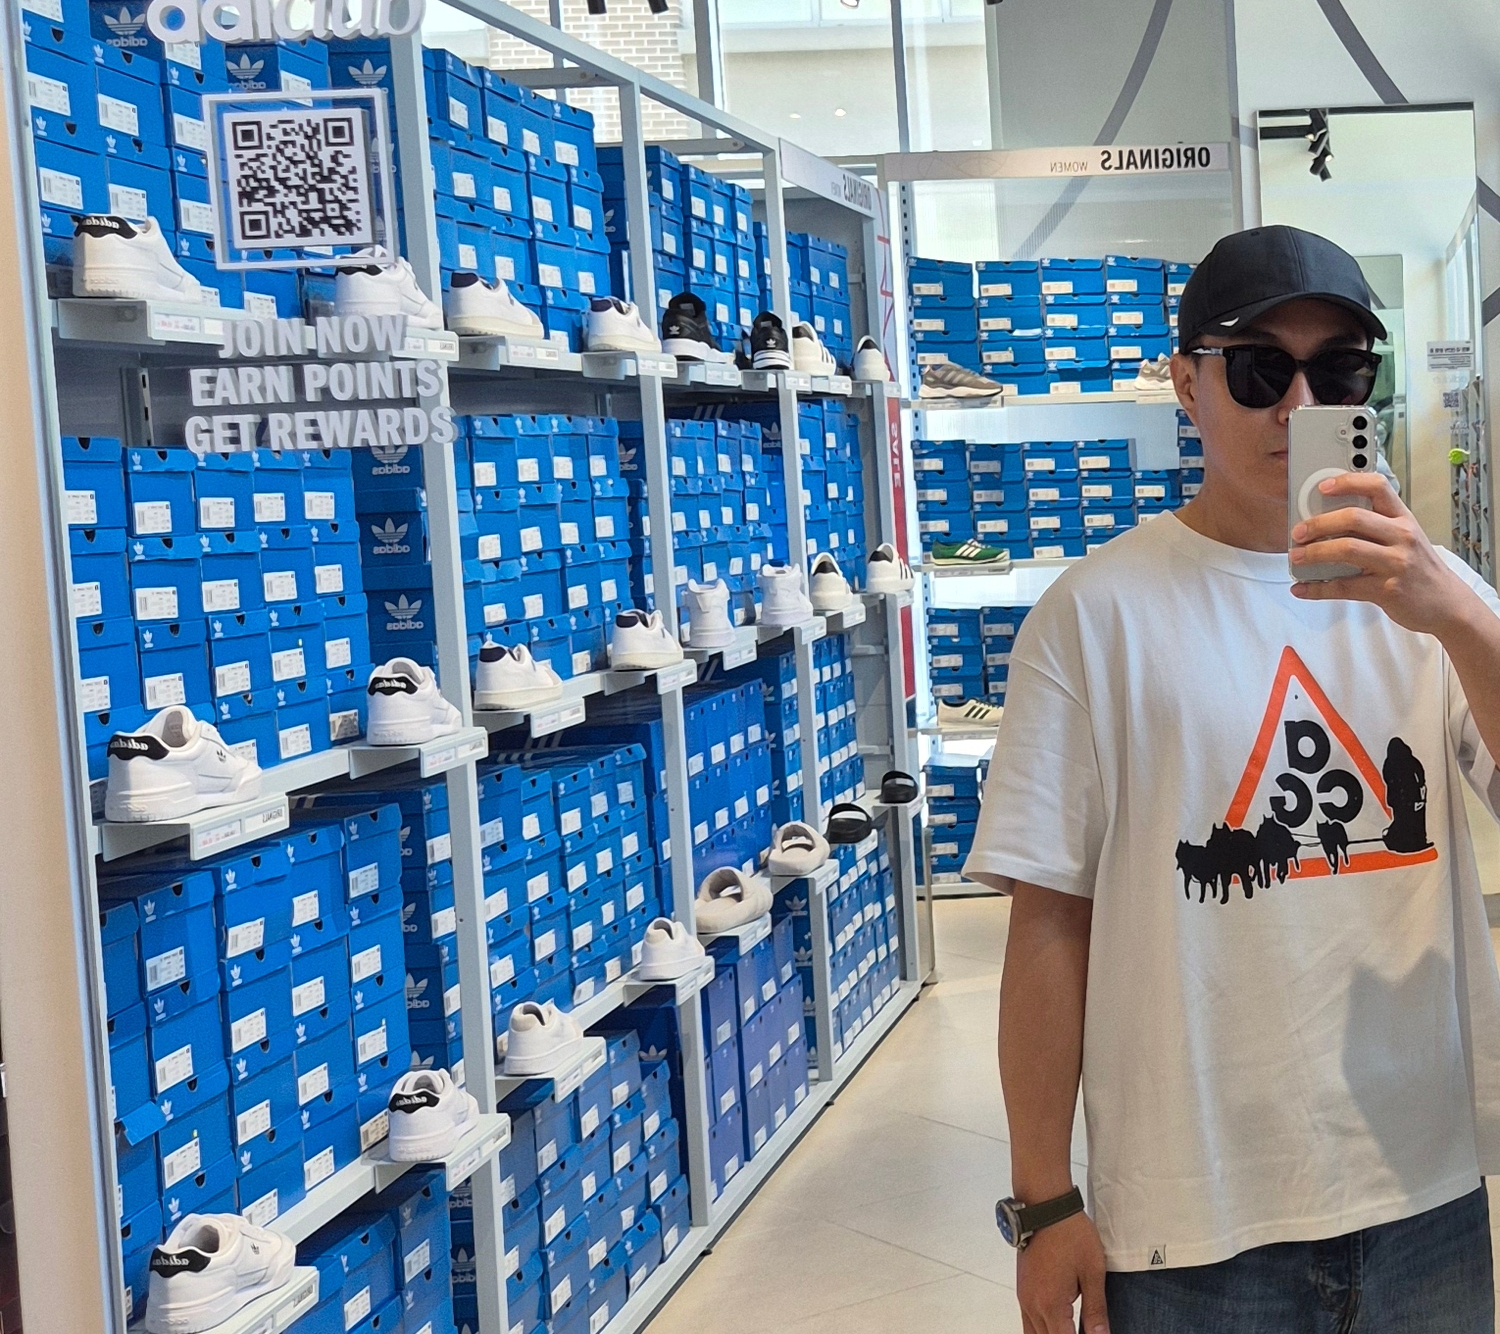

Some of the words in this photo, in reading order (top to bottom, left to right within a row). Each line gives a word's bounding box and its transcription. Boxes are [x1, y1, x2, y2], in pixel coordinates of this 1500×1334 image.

[219, 319, 309, 358] JOIN
[318, 315, 406, 353] NOW
[190, 366, 297, 406] EARN
[305, 360, 441, 400] POINTS
[186, 415, 262, 453] GET
[270, 407, 456, 451] REWARDS
